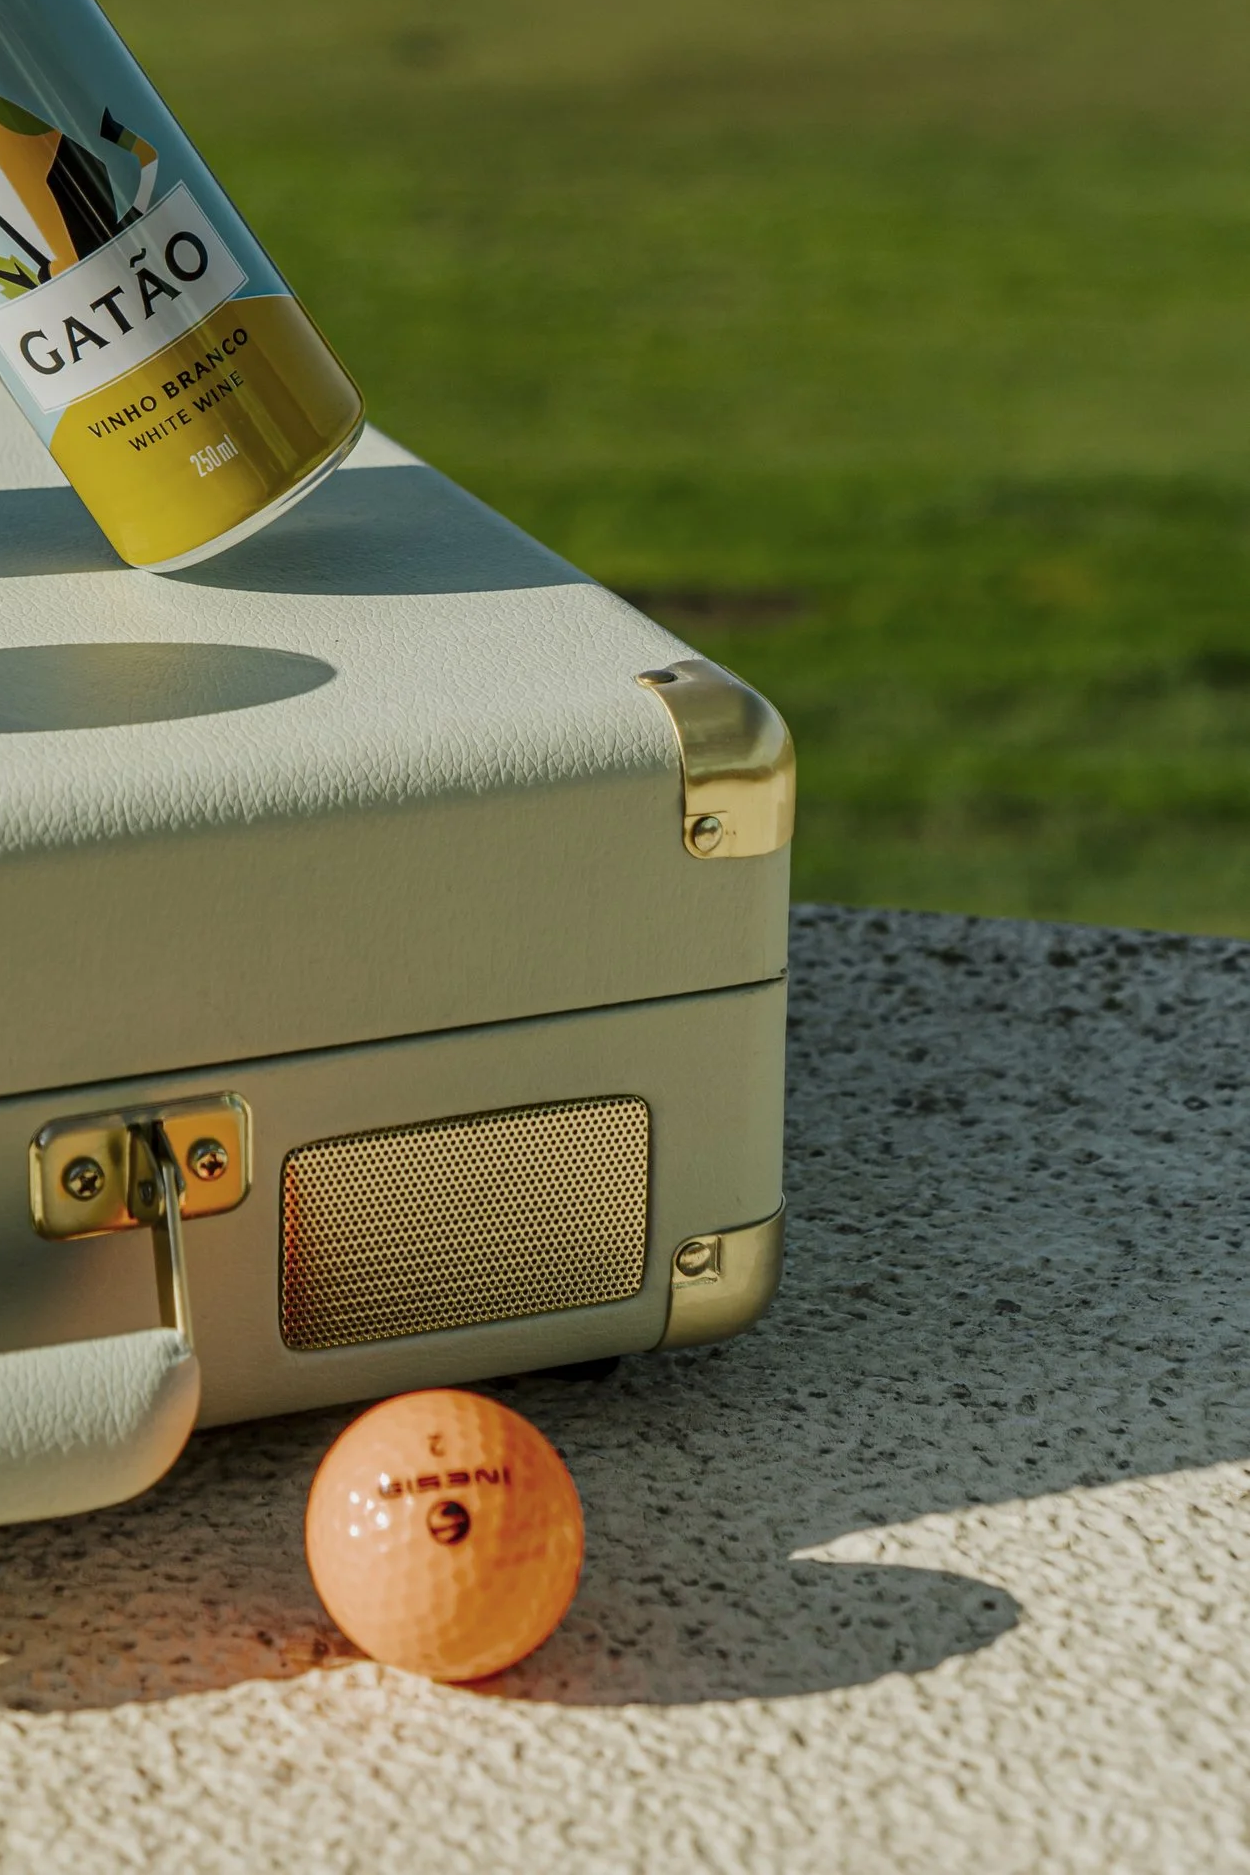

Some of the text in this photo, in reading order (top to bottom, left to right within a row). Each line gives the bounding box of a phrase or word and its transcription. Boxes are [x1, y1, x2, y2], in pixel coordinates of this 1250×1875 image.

[19, 230, 208, 375] GATÃO
[87, 327, 248, 439] VINHO BRANCO
[128, 370, 245, 452] WHITE WINE
[189, 433, 239, 478] 250ml
